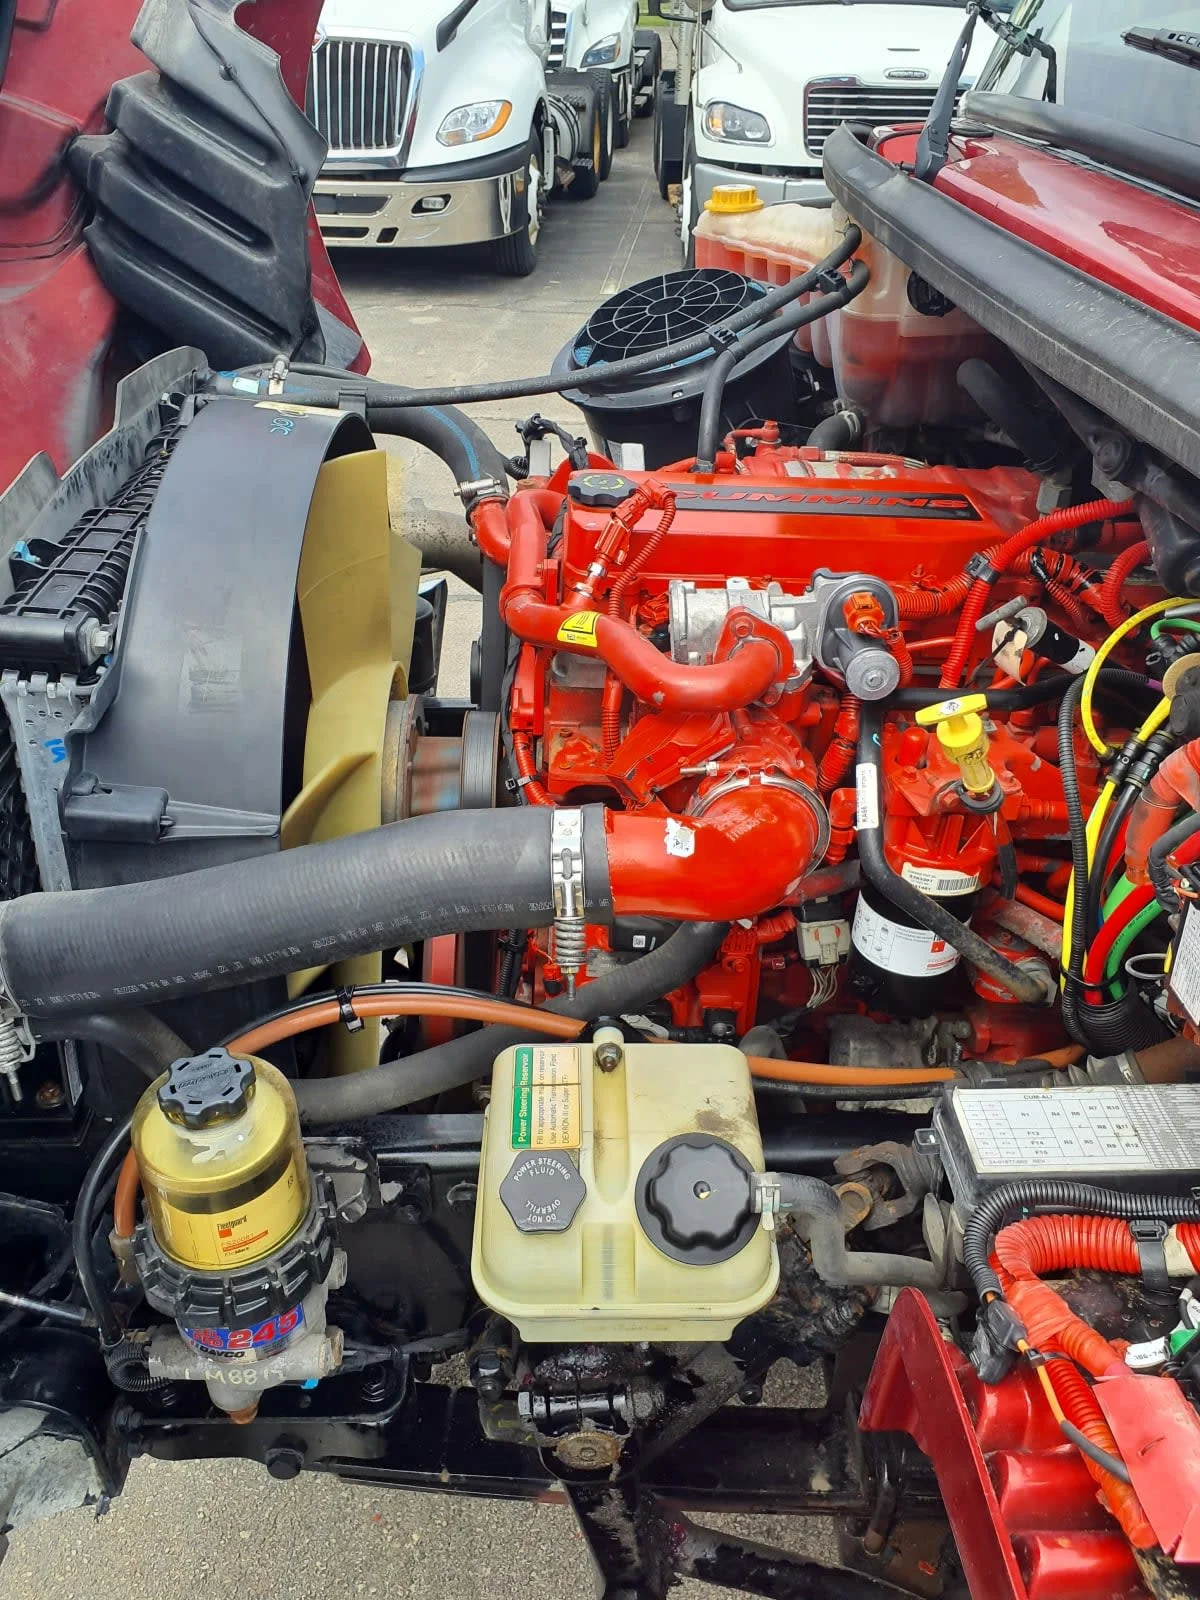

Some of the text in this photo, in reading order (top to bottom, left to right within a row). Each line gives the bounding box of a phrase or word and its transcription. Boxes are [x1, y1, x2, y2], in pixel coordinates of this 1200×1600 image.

[675, 490, 969, 509] CUMMINS
[517, 1053, 530, 1144] Power Steering Reservoir
[549, 1132, 557, 1145] Use
[561, 1120, 570, 1144] DEXRON
[536, 1136, 544, 1145] Fill
[513, 1157, 571, 1182] POWER STEERING
[529, 1167, 555, 1176] FLUID
[525, 1199, 561, 1215] OVERFILL
[527, 1213, 557, 1223] DO NOT
[227, 1308, 299, 1350] 245
[200, 1345, 246, 1358] DAVCO
